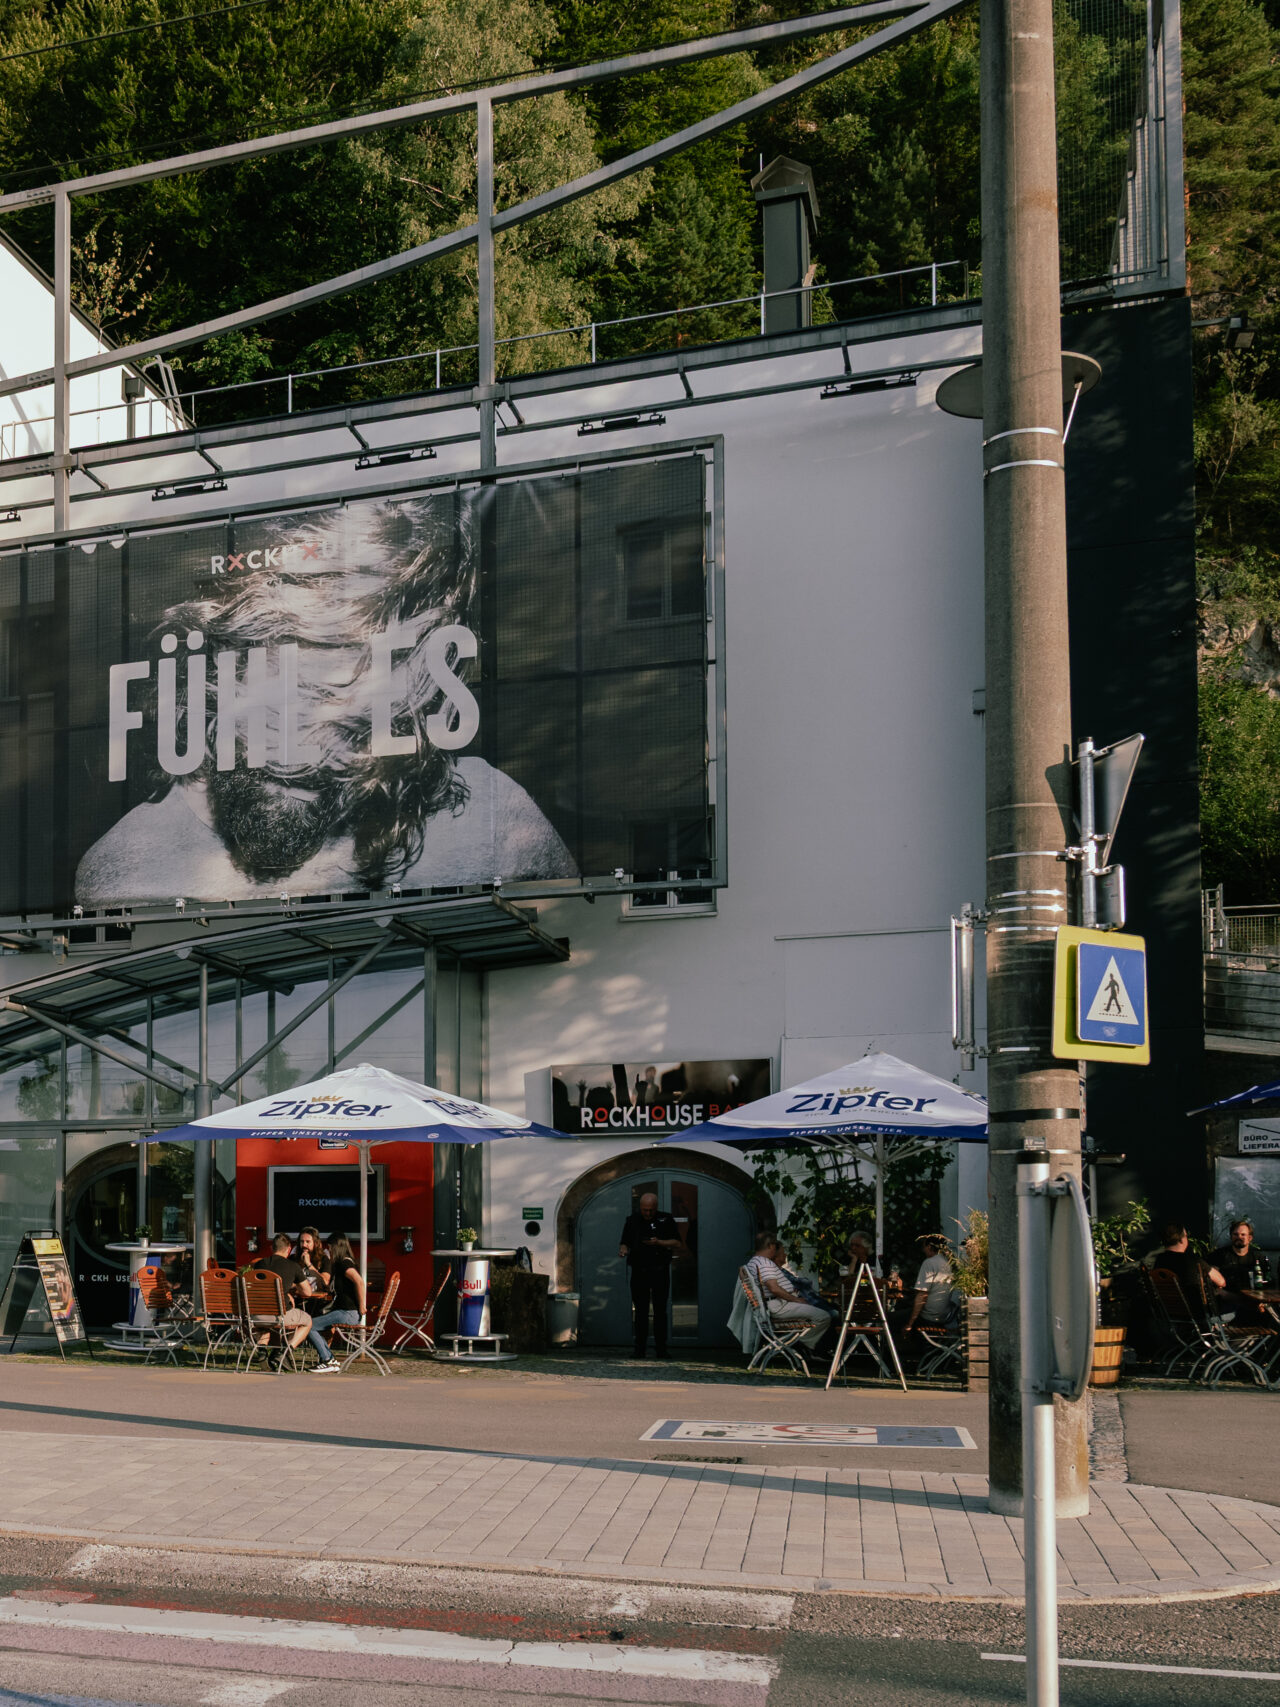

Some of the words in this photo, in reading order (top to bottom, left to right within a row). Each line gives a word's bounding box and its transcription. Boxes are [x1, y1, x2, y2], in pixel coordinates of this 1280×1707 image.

[371, 624, 481, 757] ES
[258, 1100, 393, 1120] Zipfer
[785, 1091, 938, 1116] Zipfer
[580, 1104, 704, 1129] ROCKHOUSE
[1243, 1134, 1269, 1142] BÜRO
[463, 1279, 482, 1290] Bull
